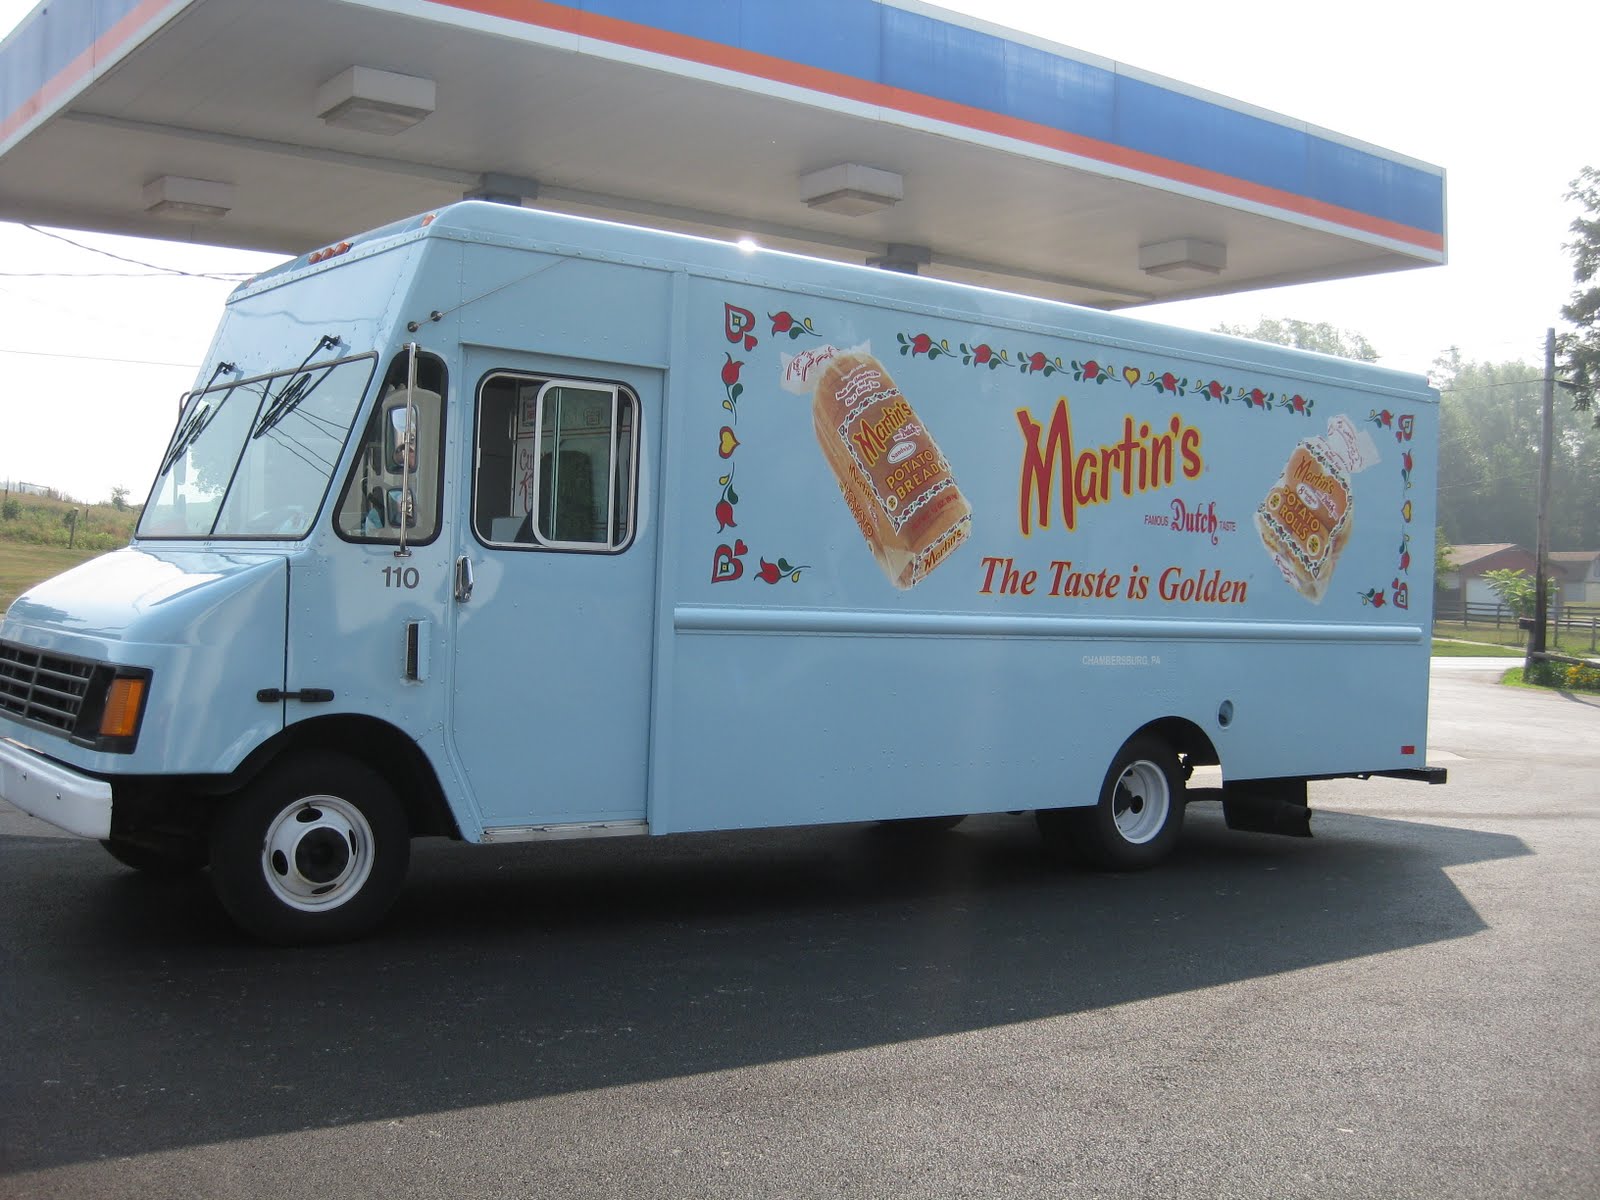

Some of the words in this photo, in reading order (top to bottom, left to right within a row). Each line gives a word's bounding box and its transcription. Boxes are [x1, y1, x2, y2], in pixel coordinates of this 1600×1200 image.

[852, 402, 913, 467] Martin's
[886, 449, 933, 489] POTATO
[895, 462, 940, 499] BREAD
[1015, 395, 1203, 539] Martin's
[1293, 455, 1335, 494] Martin's
[1143, 514, 1169, 527] FAMOUS
[1170, 498, 1219, 545] Dutch
[1219, 520, 1236, 532] TASTE
[1279, 505, 1309, 540] ROLLS
[1283, 485, 1320, 531] POTATO
[923, 529, 963, 572] Martin's
[381, 565, 420, 590] 110
[978, 556, 1038, 595] The
[1048, 560, 1121, 599] Taste
[1126, 564, 1149, 600] is
[1158, 566, 1248, 603] Golden
[1151, 655, 1161, 665] PA
